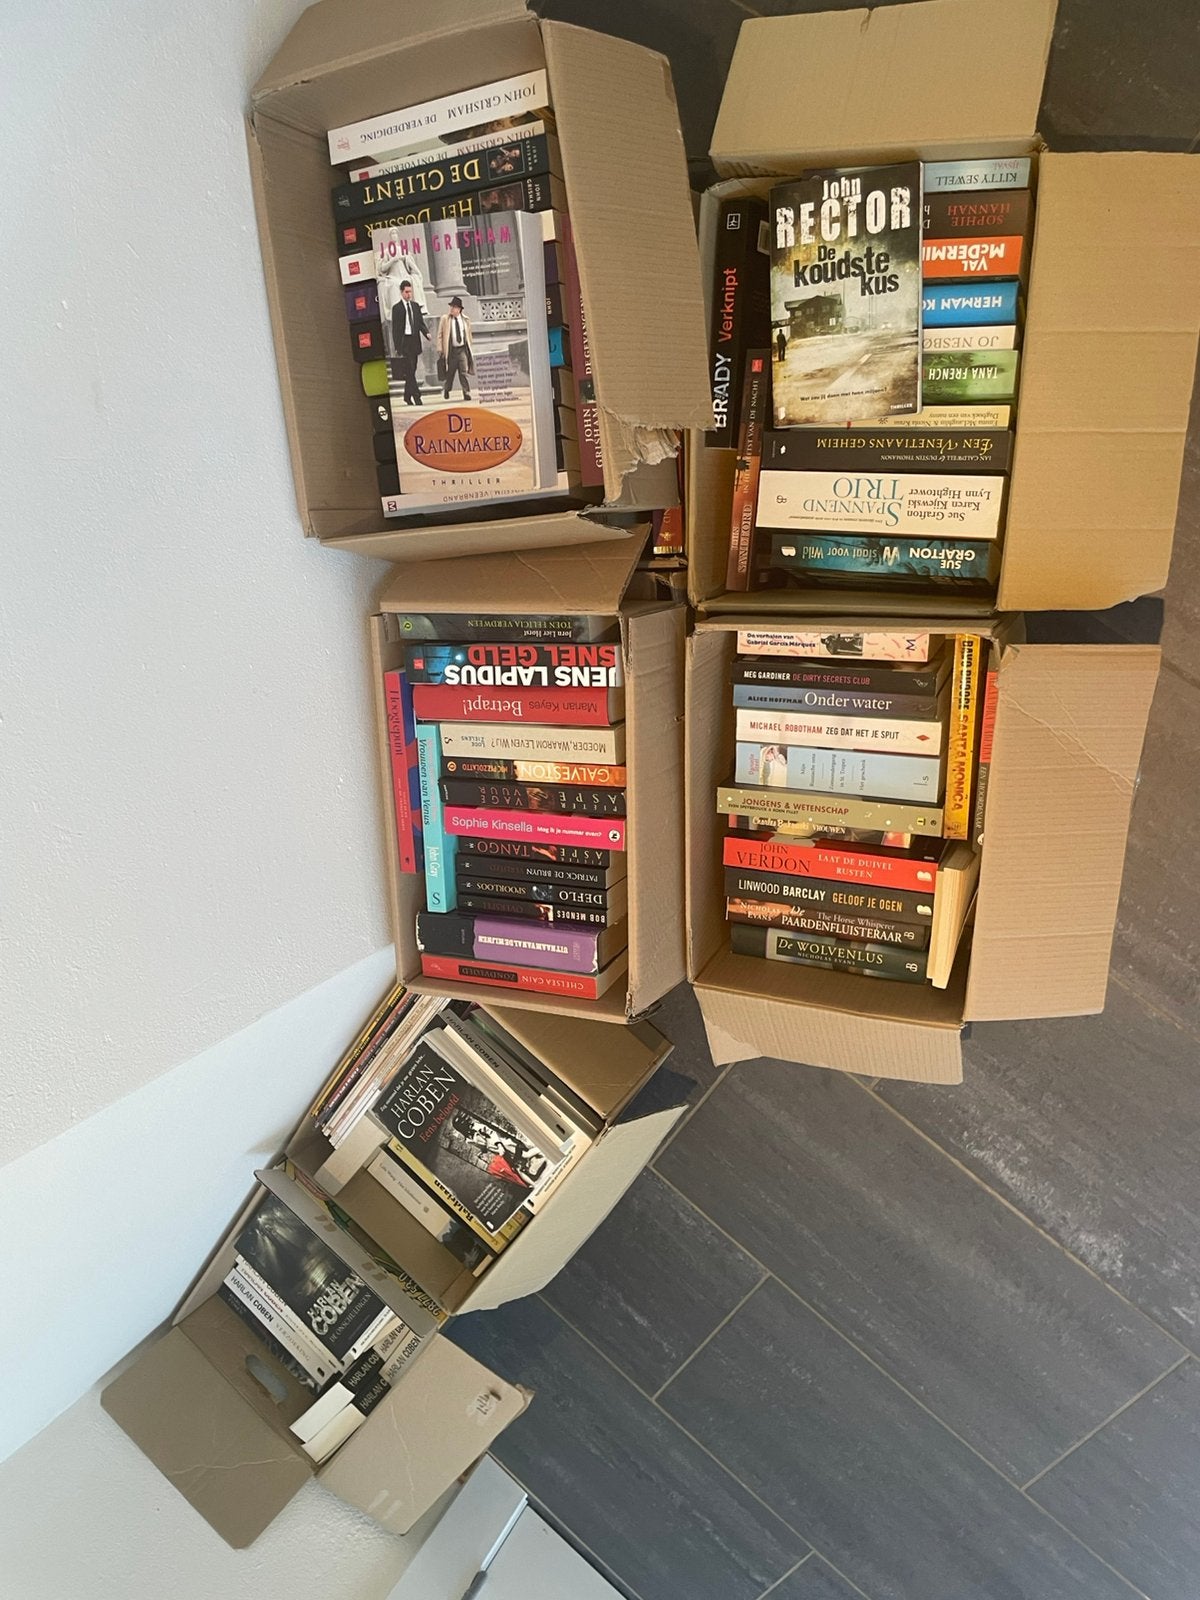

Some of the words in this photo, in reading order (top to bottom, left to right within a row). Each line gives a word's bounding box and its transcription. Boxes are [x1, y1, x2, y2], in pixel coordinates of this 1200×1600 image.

[503, 83, 536, 104] JOHN
[447, 96, 501, 119] GRISHAM
[423, 114, 437, 126] DE
[360, 118, 422, 143] VERDEDIGING
[450, 158, 480, 180] DE
[934, 174, 979, 187] SEWELL
[982, 172, 1018, 185] KITTY
[362, 169, 444, 205] CLIËNT
[822, 175, 862, 200] John
[775, 187, 912, 249] RECTOR
[947, 204, 1010, 216] HANNAH
[951, 215, 1005, 227] SOPHIE
[380, 238, 421, 259] JOHN
[432, 226, 512, 252] GRISHAM
[817, 245, 836, 262] De
[793, 246, 891, 288] koudste
[961, 258, 988, 271] VAL
[859, 273, 900, 297] kus
[718, 268, 737, 343] Verknipt
[941, 296, 1002, 309] HERMAN
[976, 335, 999, 347] JO
[928, 367, 968, 380] FRENCH
[971, 366, 999, 379] TANA
[713, 353, 732, 428] BRADY
[751, 379, 759, 407] NACHT
[749, 409, 756, 420] DE
[448, 414, 472, 434] DE
[582, 408, 592, 443] JOHN
[415, 436, 513, 455] RAINMAKER
[816, 437, 866, 449] GEHEIM
[869, 437, 959, 452] VENETIAANS
[962, 437, 993, 456] EEN
[432, 478, 502, 487] THRILLER
[833, 477, 905, 500] TRIO
[442, 491, 491, 503] VEENBRAND
[908, 487, 961, 499] Hightower
[965, 488, 991, 500] Lynn
[803, 497, 902, 527] SPANNEND
[907, 498, 948, 510] Kijewski
[952, 500, 981, 510] Karen
[906, 509, 945, 521] Grafton
[948, 510, 966, 521] Sue
[802, 546, 824, 559] Wild
[826, 547, 849, 558] voor
[851, 548, 877, 561] staat
[882, 545, 901, 567] W
[909, 547, 976, 561] GRAFTON
[940, 559, 962, 570] SUE
[467, 619, 513, 628] VERDWEEN
[545, 621, 572, 629] TOEN
[523, 629, 542, 637] Horst
[543, 630, 556, 638] Lier
[557, 630, 572, 638] Jorn
[467, 645, 538, 664] GELD
[544, 646, 615, 665] SNEL
[444, 665, 548, 685] LAPIDUS
[554, 665, 617, 687] JENS
[743, 670, 757, 679] MEG
[757, 671, 791, 681] GARDINER
[792, 673, 802, 681] DE
[802, 674, 821, 683] DIRTY
[823, 675, 851, 685] SECRETS
[852, 677, 870, 685] CLUB
[461, 695, 523, 717] Betrapt!
[528, 700, 560, 713] Keyes
[562, 702, 598, 713] Marian
[769, 697, 803, 705] HOFFMAN
[804, 691, 850, 708] Onder
[852, 696, 892, 711] water
[749, 721, 782, 732] MICHAEL
[784, 725, 823, 735] ROBOTHAM
[825, 726, 839, 736] ZEG
[840, 727, 854, 737] DAT
[855, 728, 869, 738] HET
[870, 729, 879, 739] JE
[881, 730, 900, 740] SPIJT
[955, 714, 970, 759] SANTA
[418, 738, 429, 779] Vrouwen
[520, 764, 610, 783] GALVESTON
[422, 780, 430, 797] van
[478, 786, 521, 797] VUUR
[951, 760, 968, 811] MONICA
[480, 795, 524, 806] VAGE
[558, 791, 617, 805] ASPE
[741, 797, 782, 808] JONGENS
[785, 800, 790, 809] &
[793, 802, 850, 815] WETENSCHAP
[422, 799, 431, 825] Venus
[560, 802, 617, 813] PIETER
[451, 816, 488, 829] Sophie
[491, 820, 533, 834] Kinsella
[428, 846, 439, 862] John
[476, 840, 530, 856] TANGO
[559, 848, 603, 859] ASPE
[760, 843, 788, 855] JOHN
[428, 862, 440, 878] Gray
[736, 851, 811, 874] VERDON
[818, 854, 840, 864] LAAT
[842, 857, 856, 866] DE
[857, 859, 893, 870] DUIVEL
[526, 867, 552, 878] BRUYN
[566, 871, 598, 882] PATRICK
[836, 867, 873, 879] RUSTEN
[476, 882, 527, 895] SPOORLOOS
[738, 879, 780, 895] LINWOOD
[782, 882, 826, 901] BARCLAY
[832, 892, 865, 907] GELOOF
[866, 898, 877, 909] JE
[879, 899, 903, 912] OGEN
[558, 890, 603, 904] DEFLO
[556, 910, 586, 921] MENDES
[589, 914, 606, 923] BOB
[816, 912, 831, 920] The
[832, 913, 856, 924] Horse
[857, 916, 895, 931] Whisperer
[781, 915, 902, 943] PAARDENFLUISTERAAR
[777, 937, 794, 951] De
[795, 940, 883, 965] WOLVENLUS
[797, 952, 832, 962] NICHOLAS
[833, 957, 856, 966] EVANS
[521, 975, 544, 986] CAIN
[545, 977, 584, 990] CHELSEA
[445, 1015, 476, 1044] HARLAN
[474, 1042, 500, 1068] COBEN
[390, 1064, 436, 1118] HARLAN
[396, 1066, 456, 1140] COBEN
[230, 1275, 255, 1304] HARLAN
[252, 1299, 274, 1323] COBEN
[307, 1279, 341, 1320] HARLAN
[311, 1274, 367, 1336] COBEN
[379, 1327, 399, 1354] HARLAN
[386, 1351, 406, 1380] HARLAN
[402, 1336, 422, 1359] COBEN
[347, 1362, 372, 1388] HARLAN
[359, 1382, 382, 1410] HARLAN
